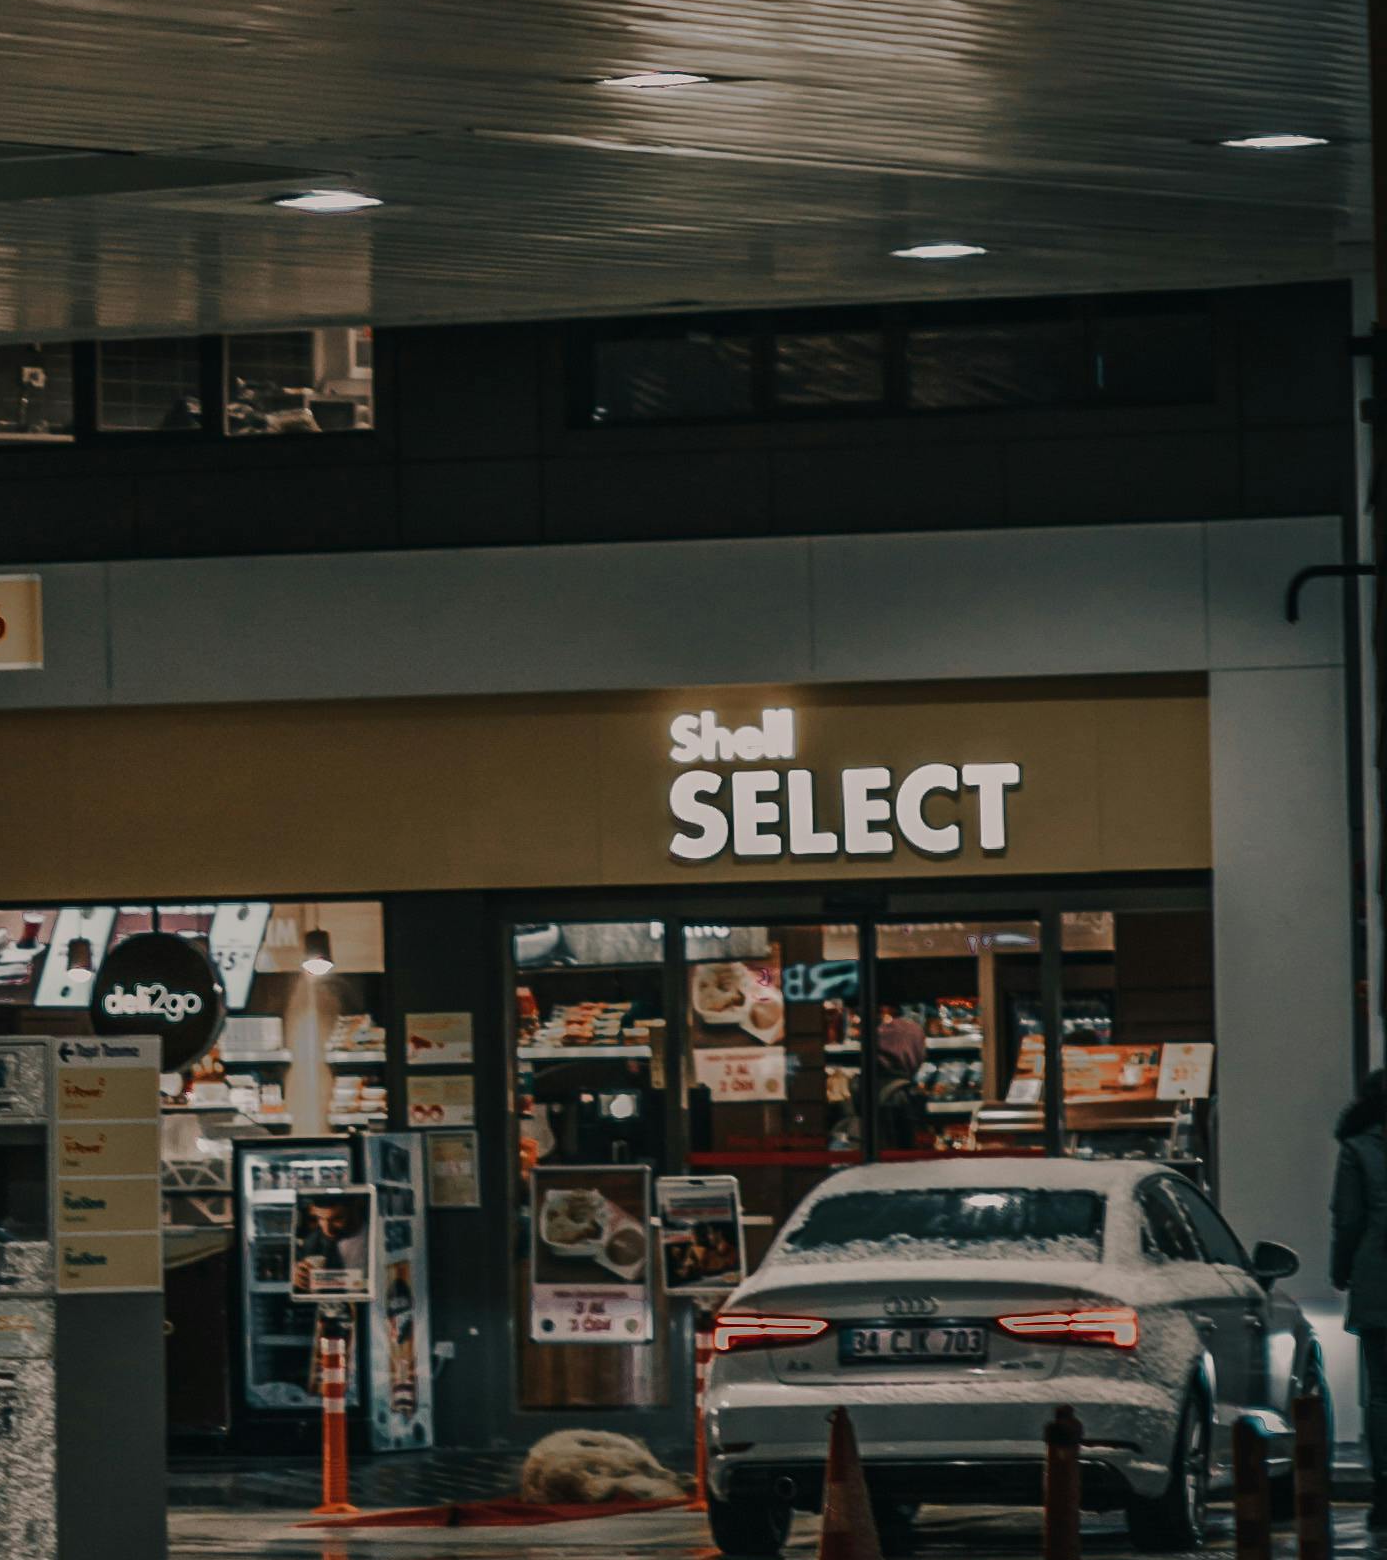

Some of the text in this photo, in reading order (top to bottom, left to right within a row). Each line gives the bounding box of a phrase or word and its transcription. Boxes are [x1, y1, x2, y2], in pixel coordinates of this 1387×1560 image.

[669, 708, 796, 763] Shell
[668, 761, 1021, 861] SELECT
[103, 983, 204, 1023] deli2go
[854, 1330, 879, 1353] 34
[943, 1329, 982, 1353] 703
